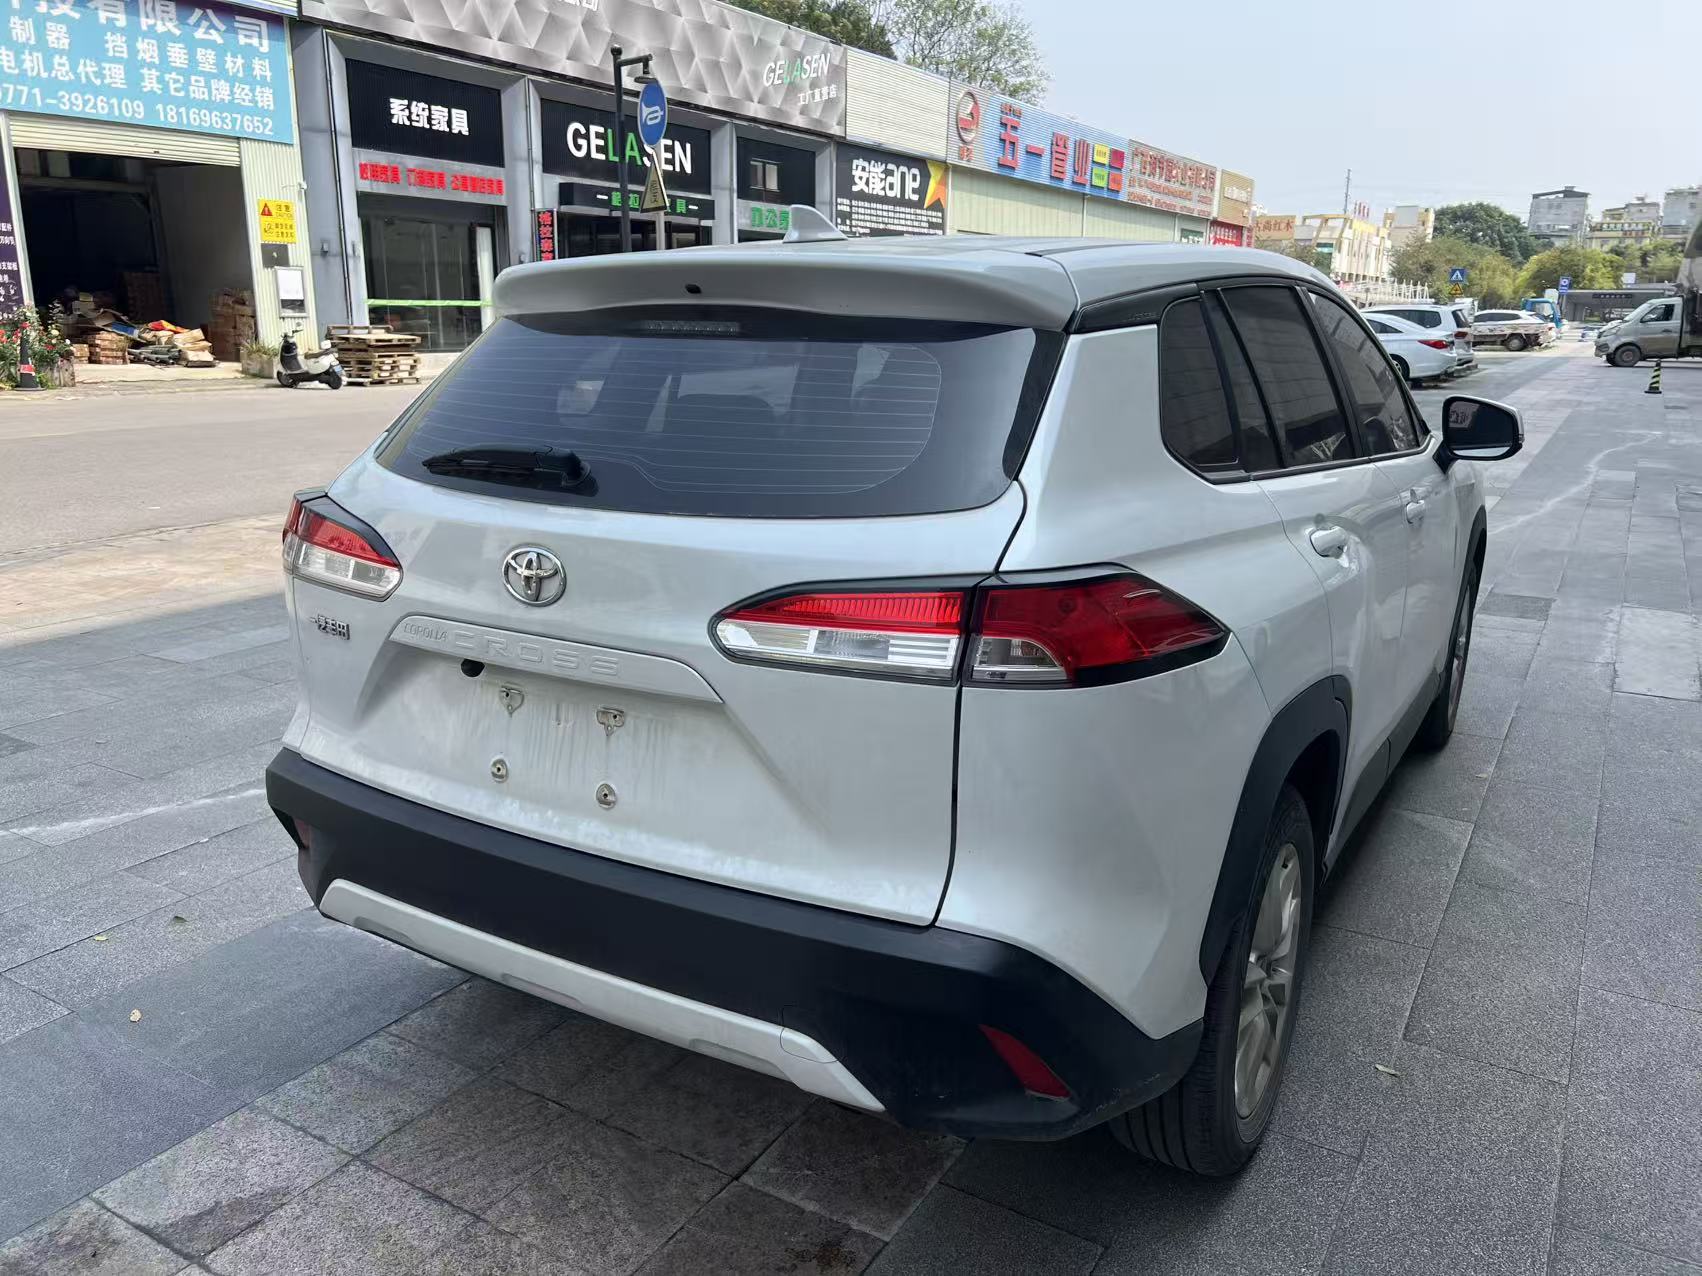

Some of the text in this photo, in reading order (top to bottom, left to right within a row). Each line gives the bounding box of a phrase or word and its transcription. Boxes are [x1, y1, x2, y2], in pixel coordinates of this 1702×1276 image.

[9, 16, 273, 82] 制器 挡烟垂壁材料
[11, 0, 270, 53] 有限公司
[0, 46, 275, 110] 电机总代理 其它品牌经销
[763, 53, 830, 87] GELASEN
[0, 84, 273, 135] 771-3926109 18169637652
[390, 98, 470, 136] 系统家具
[403, 622, 620, 677] COROLLA CROSS
